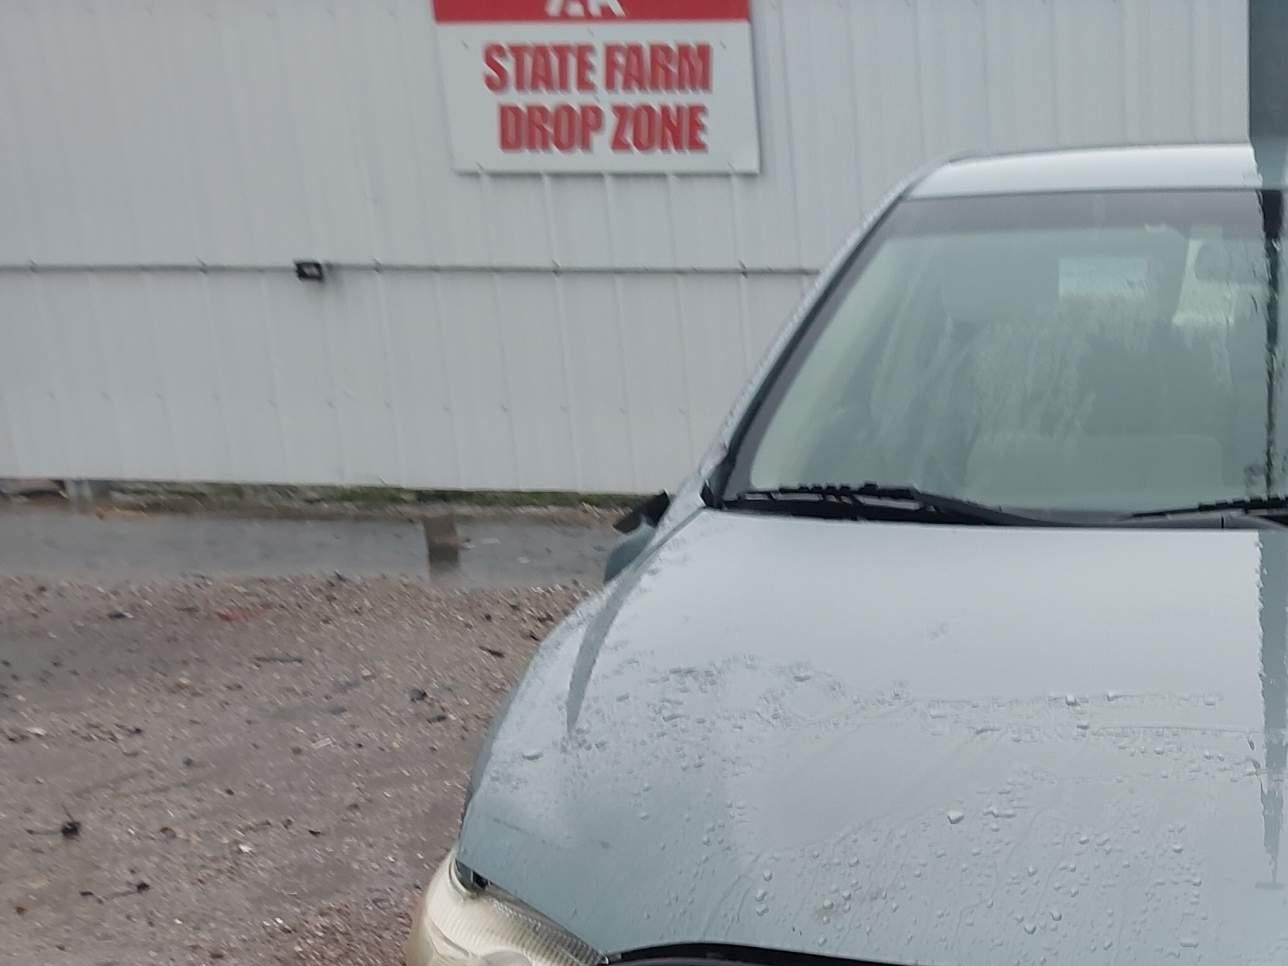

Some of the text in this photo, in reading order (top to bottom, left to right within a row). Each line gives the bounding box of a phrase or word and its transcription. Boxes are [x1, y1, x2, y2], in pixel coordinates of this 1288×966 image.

[483, 41, 711, 93] STATE FARM
[497, 103, 707, 153] DROP ZONE
